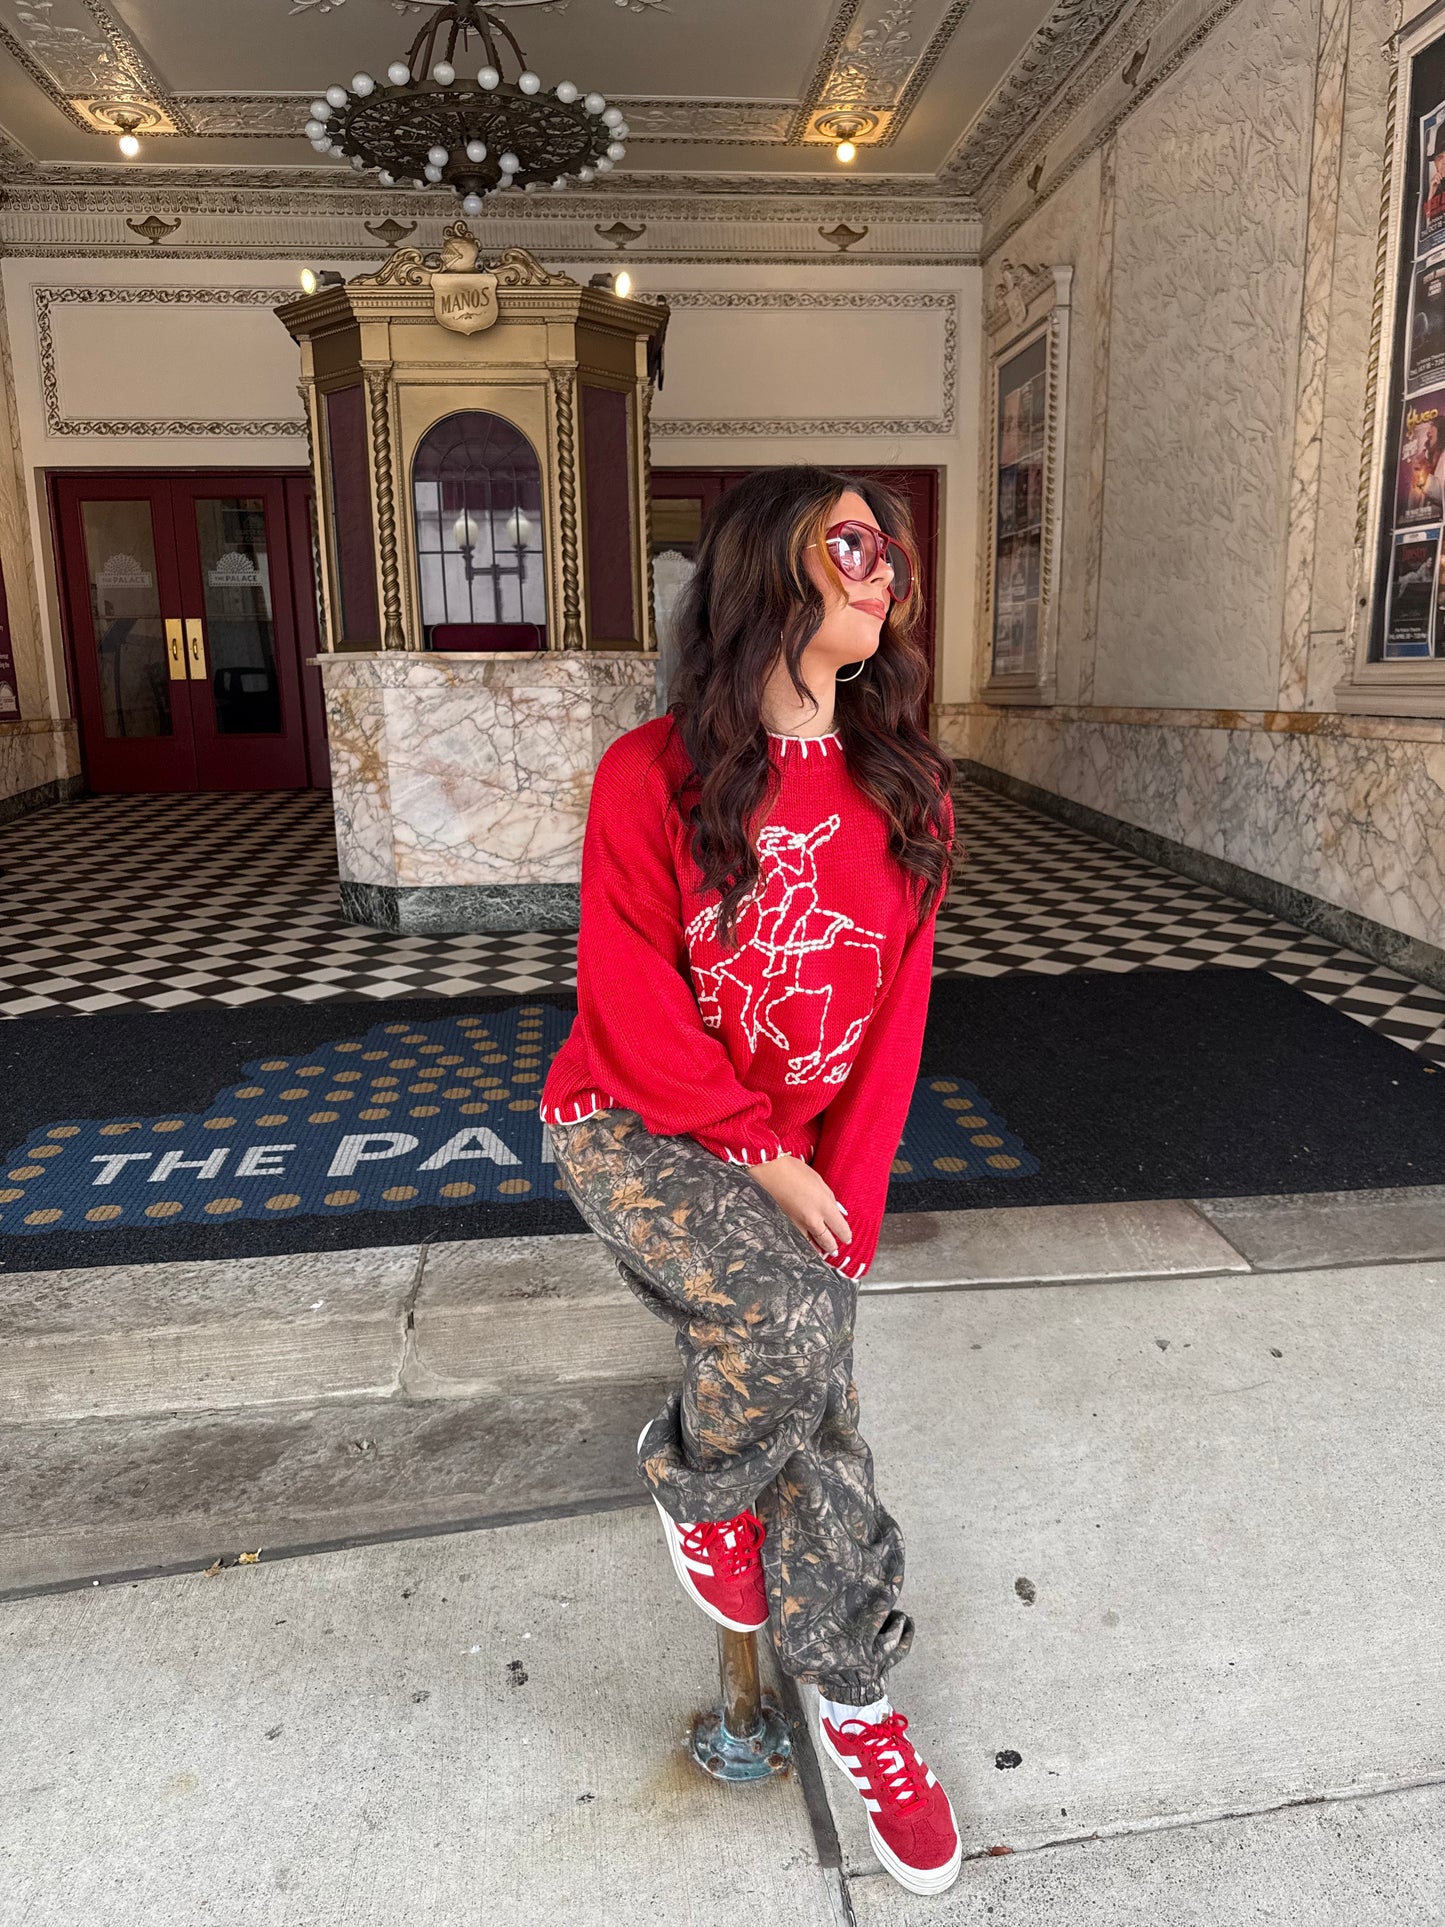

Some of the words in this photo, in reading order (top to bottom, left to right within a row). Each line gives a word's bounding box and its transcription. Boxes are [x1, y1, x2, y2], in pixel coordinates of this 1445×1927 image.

[441, 286, 491, 315] MANOS
[1406, 405, 1439, 431] HUGO
[112, 576, 145, 584] PALACE
[90, 1143, 297, 1186] THE
